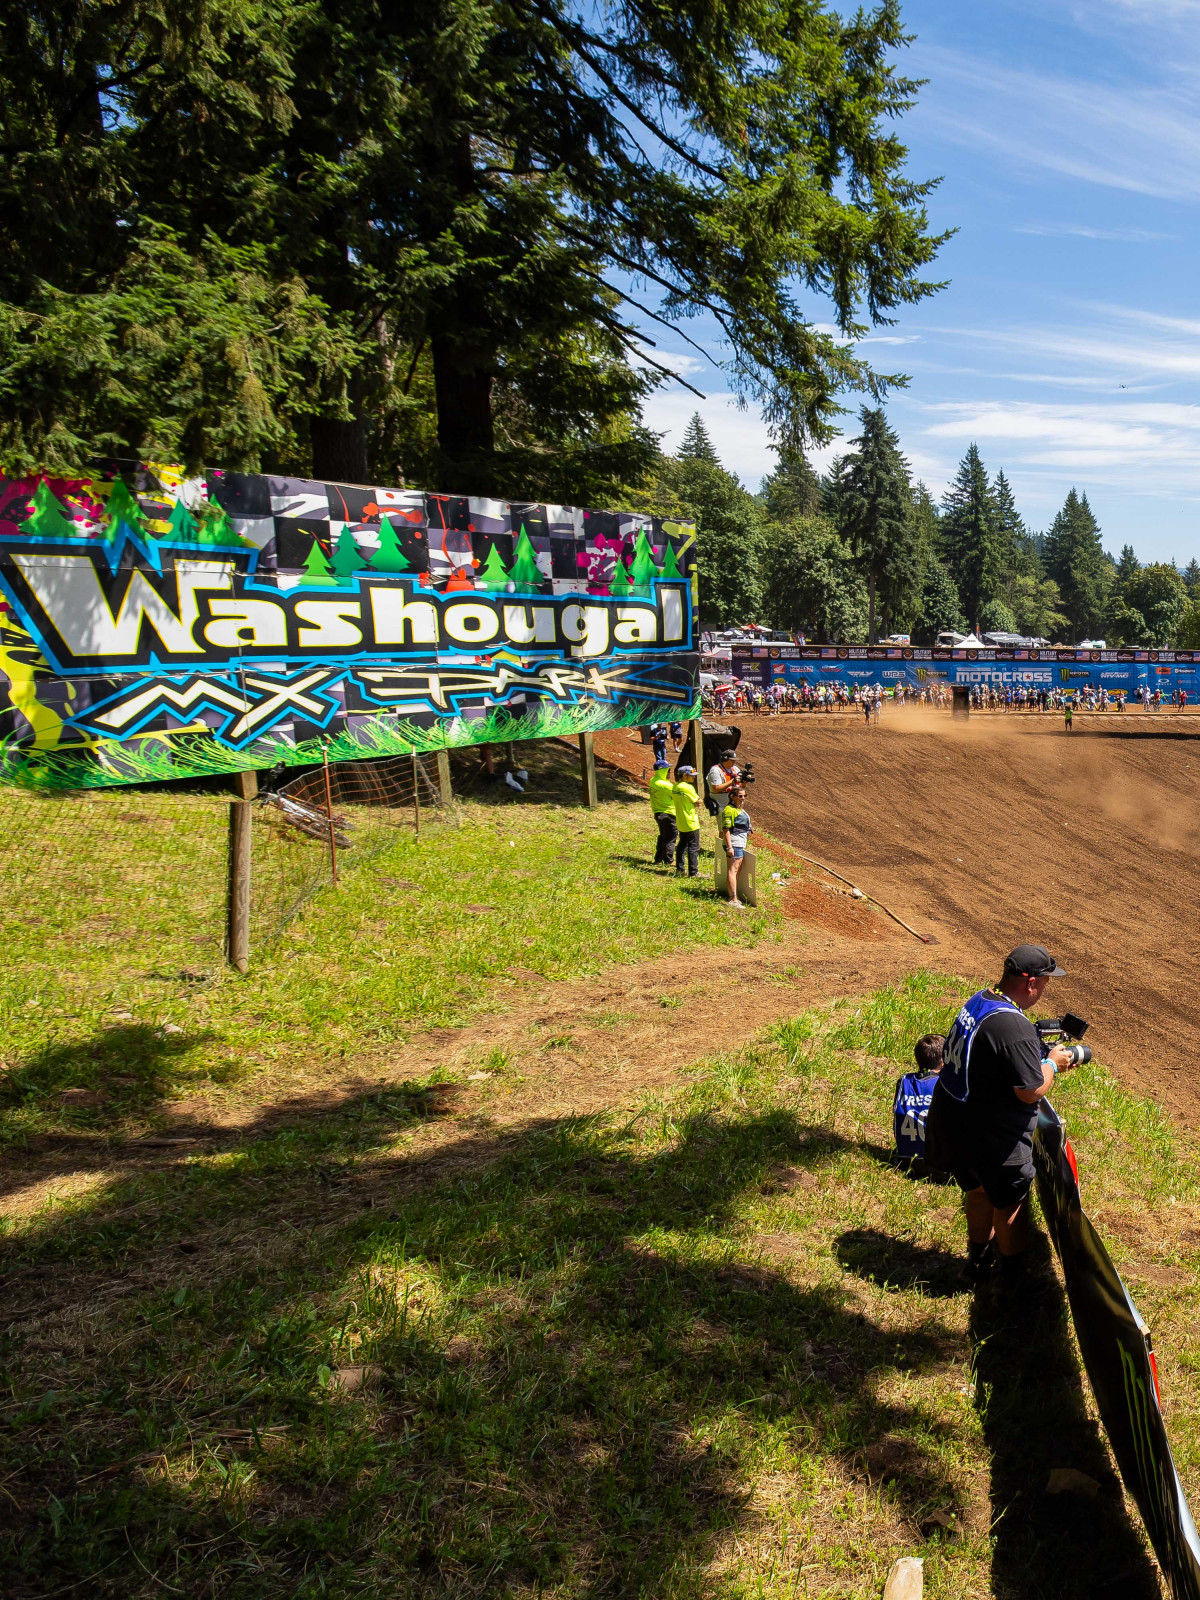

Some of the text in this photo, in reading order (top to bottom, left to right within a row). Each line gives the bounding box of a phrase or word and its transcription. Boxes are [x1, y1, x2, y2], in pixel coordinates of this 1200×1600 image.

[9, 553, 685, 657] Washougal
[956, 671, 1053, 682] MOTOCROSS
[94, 667, 686, 738] MX PARK
[900, 1094, 933, 1107] PRES
